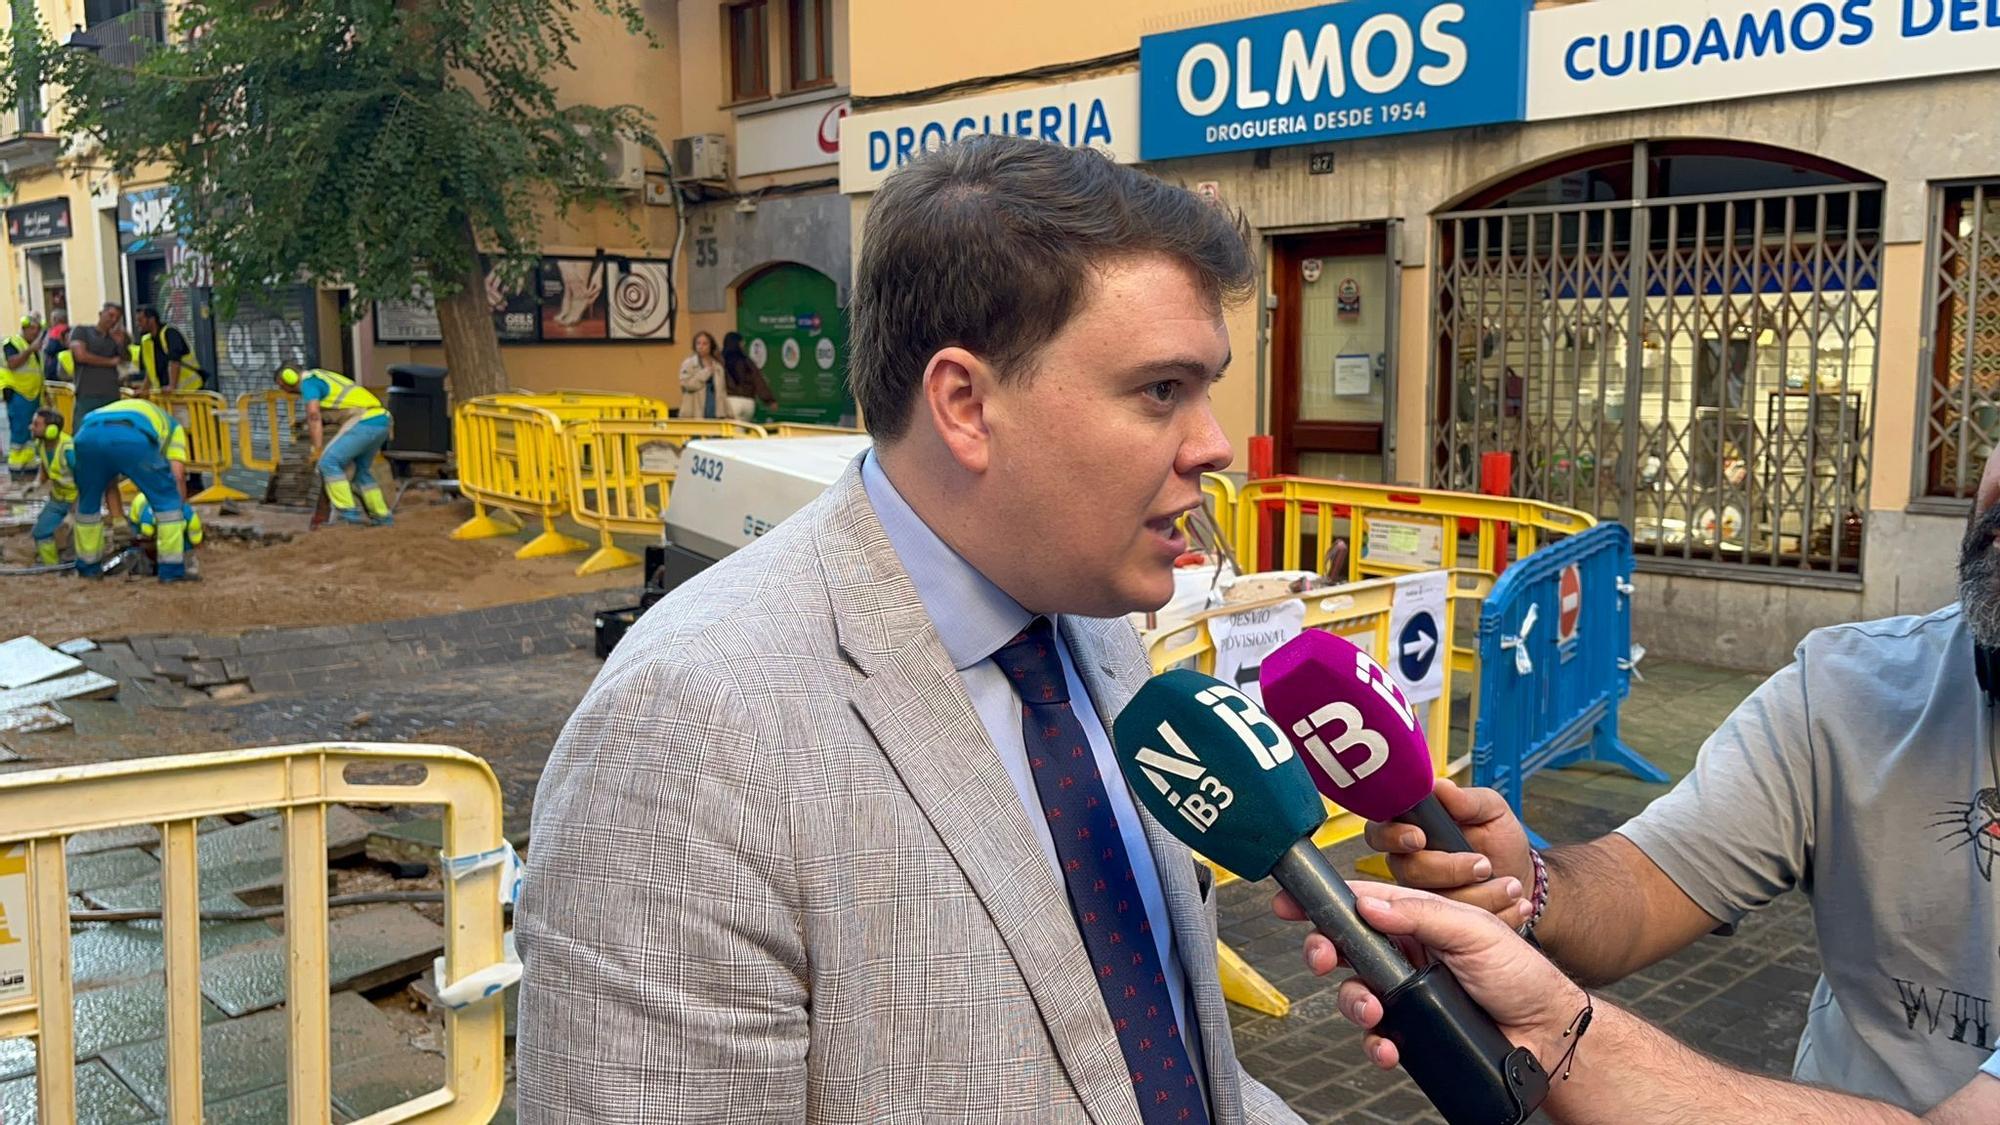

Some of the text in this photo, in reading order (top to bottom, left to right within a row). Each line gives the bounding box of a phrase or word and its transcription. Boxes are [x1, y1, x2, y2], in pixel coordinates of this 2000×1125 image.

[1564, 0, 1874, 81] CUIDAMOS
[1176, 3, 1467, 117] OLMOS
[1206, 101, 1427, 143] DROGUERIA DESDE 1954
[1312, 155, 1332, 171] 37
[696, 237, 718, 268] 35
[691, 455, 724, 482] 3432
